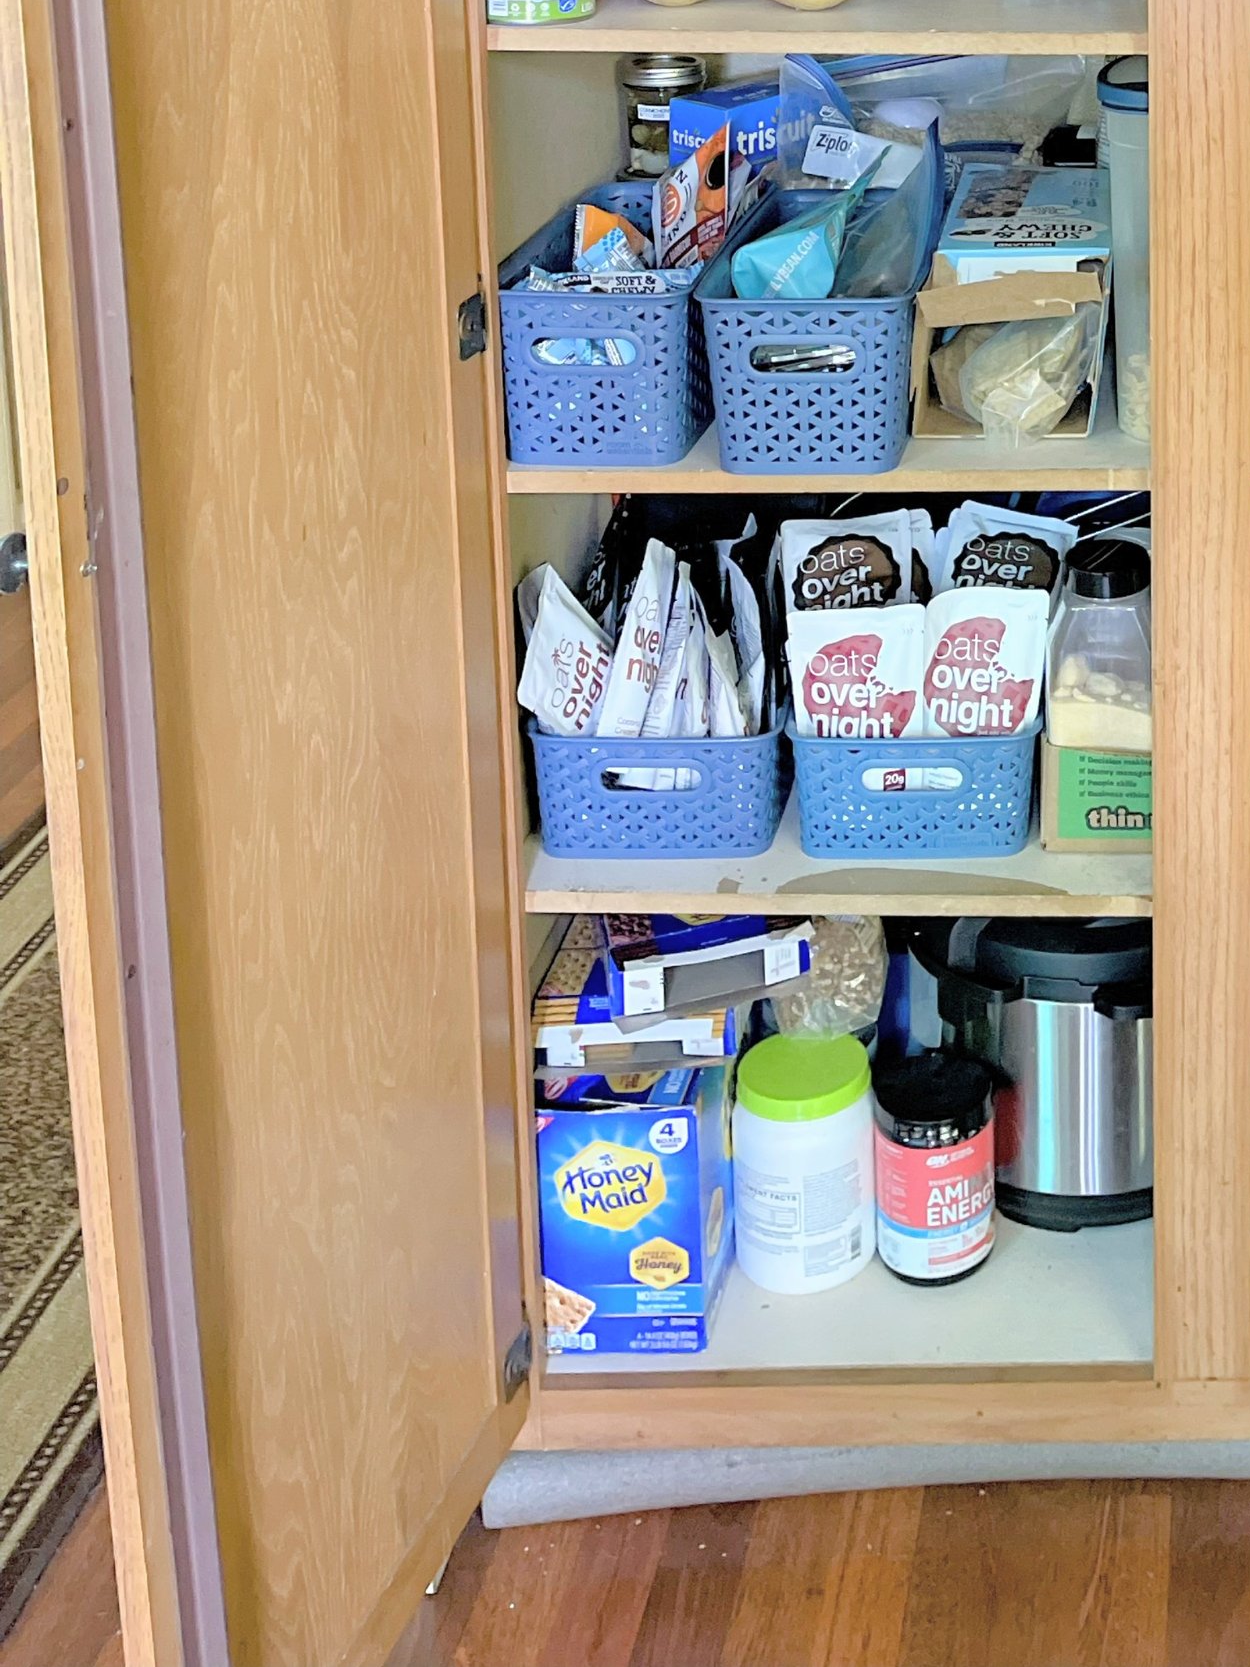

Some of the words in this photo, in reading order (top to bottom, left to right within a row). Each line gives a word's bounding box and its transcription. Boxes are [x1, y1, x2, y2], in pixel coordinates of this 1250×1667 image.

[998, 223, 1092, 232] CHEWY
[1021, 231, 1080, 239] SOFT
[615, 276, 646, 287] SOFT
[646, 276, 656, 286] &
[800, 545, 865, 574] oats
[966, 537, 1030, 562] oats
[961, 554, 1033, 581] over
[801, 565, 871, 599] over
[804, 582, 884, 611] night
[935, 634, 999, 662] oats
[551, 638, 574, 708] oats
[808, 654, 876, 677] oats
[563, 642, 592, 718] over
[574, 643, 610, 730] night
[931, 665, 1001, 694] over
[810, 682, 883, 708] over
[812, 708, 894, 738] night
[929, 696, 1013, 735] night
[1088, 757, 1121, 765] Decision
[885, 774, 905, 786] 20g
[1087, 806, 1144, 829] thin
[656, 1137, 682, 1145] BOXES
[659, 1123, 674, 1136] 4
[562, 1162, 653, 1194] Honey
[579, 1183, 647, 1214] Maid
[635, 1258, 682, 1274] Honey
